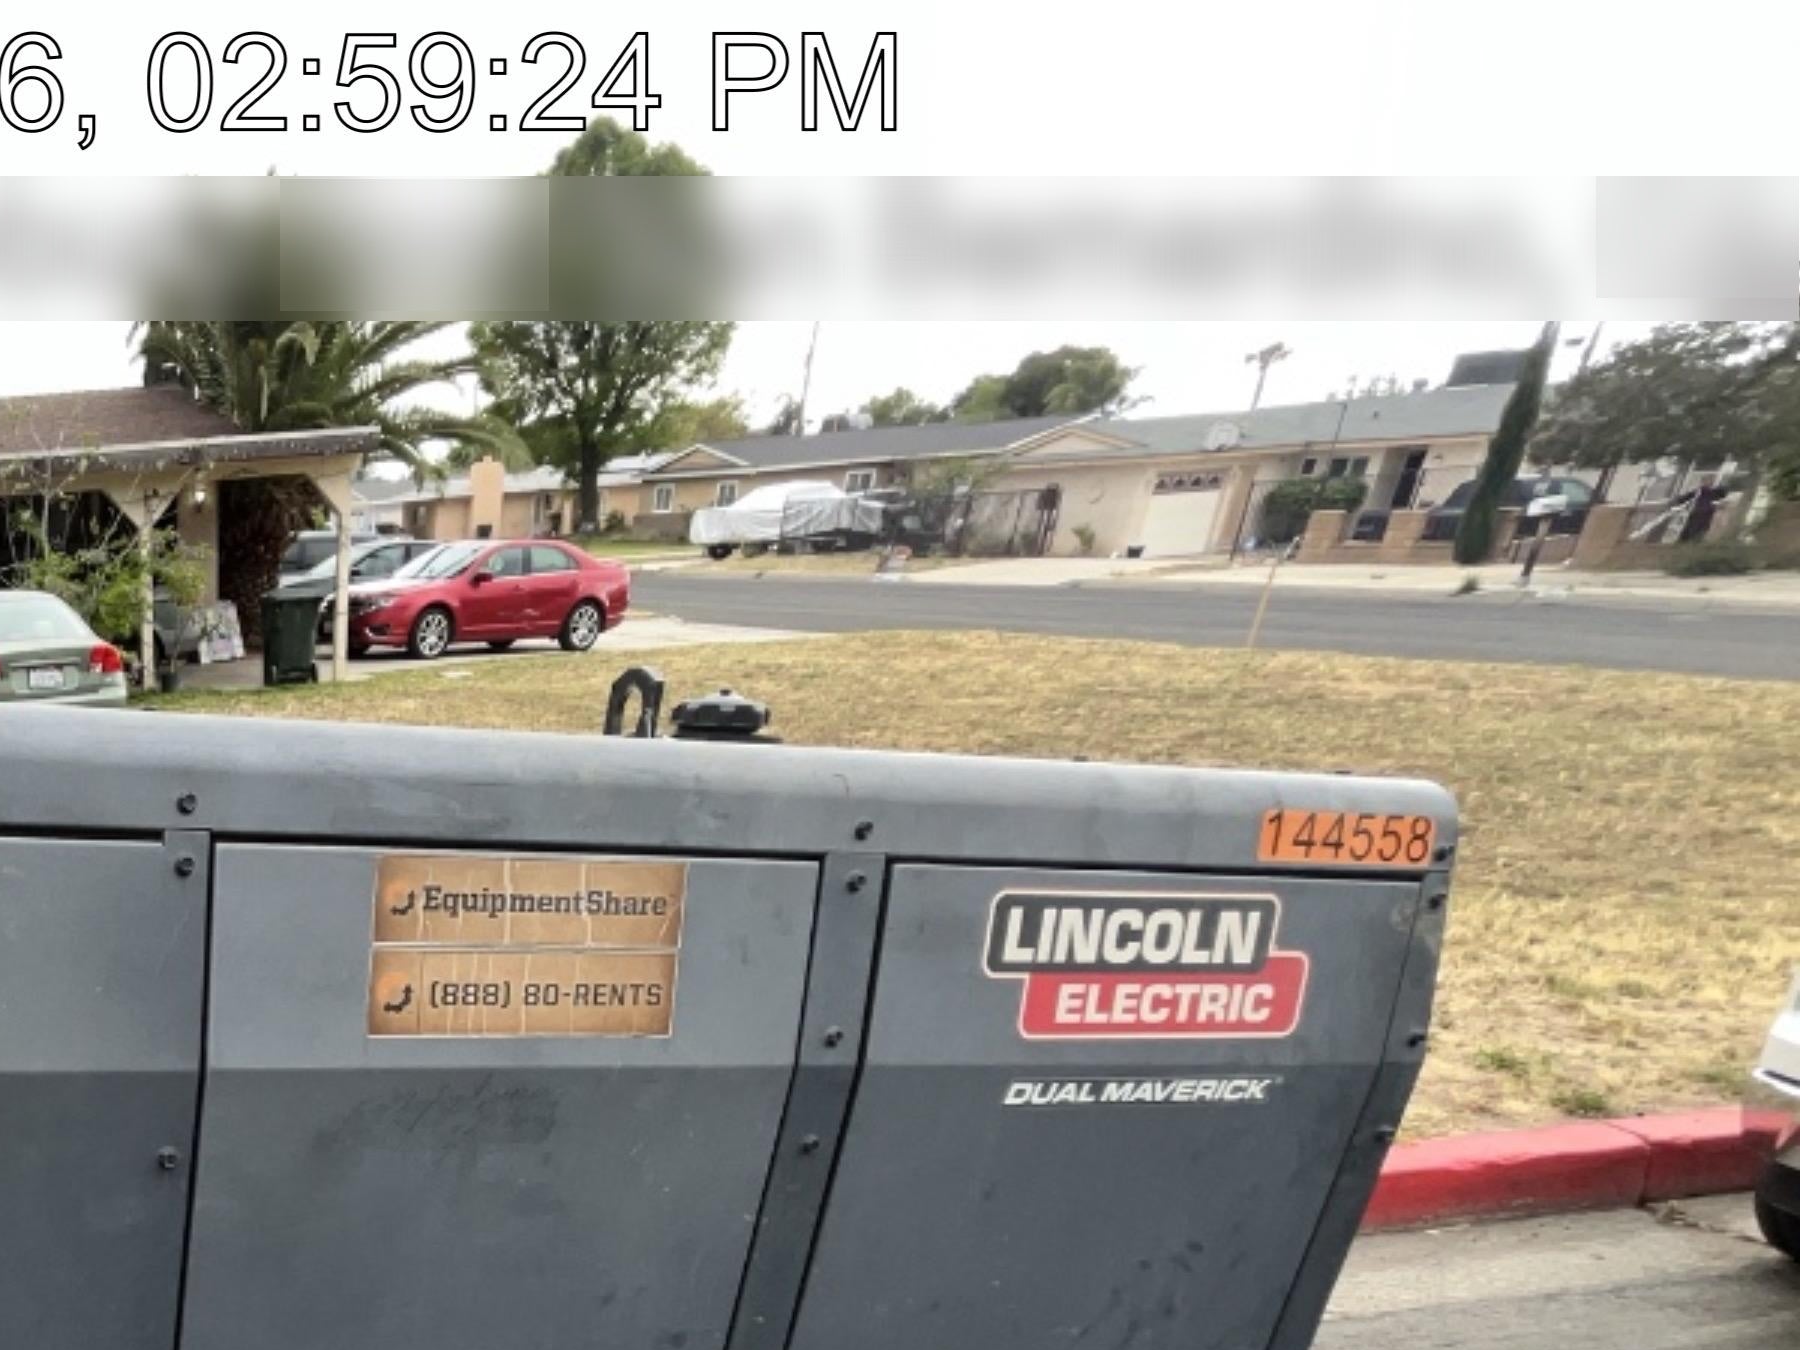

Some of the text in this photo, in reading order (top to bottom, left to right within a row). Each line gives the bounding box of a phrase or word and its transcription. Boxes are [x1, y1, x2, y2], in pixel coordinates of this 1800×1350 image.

[1268, 809, 1432, 862] 144558
[423, 885, 668, 918] EquipmentShare
[1001, 906, 1261, 964] LINCOLN
[431, 981, 665, 1008] (888) 80-RENTS
[1054, 983, 1274, 1024] ELECTRIC
[1003, 1078, 1272, 1105] DUAL MAVERICK
